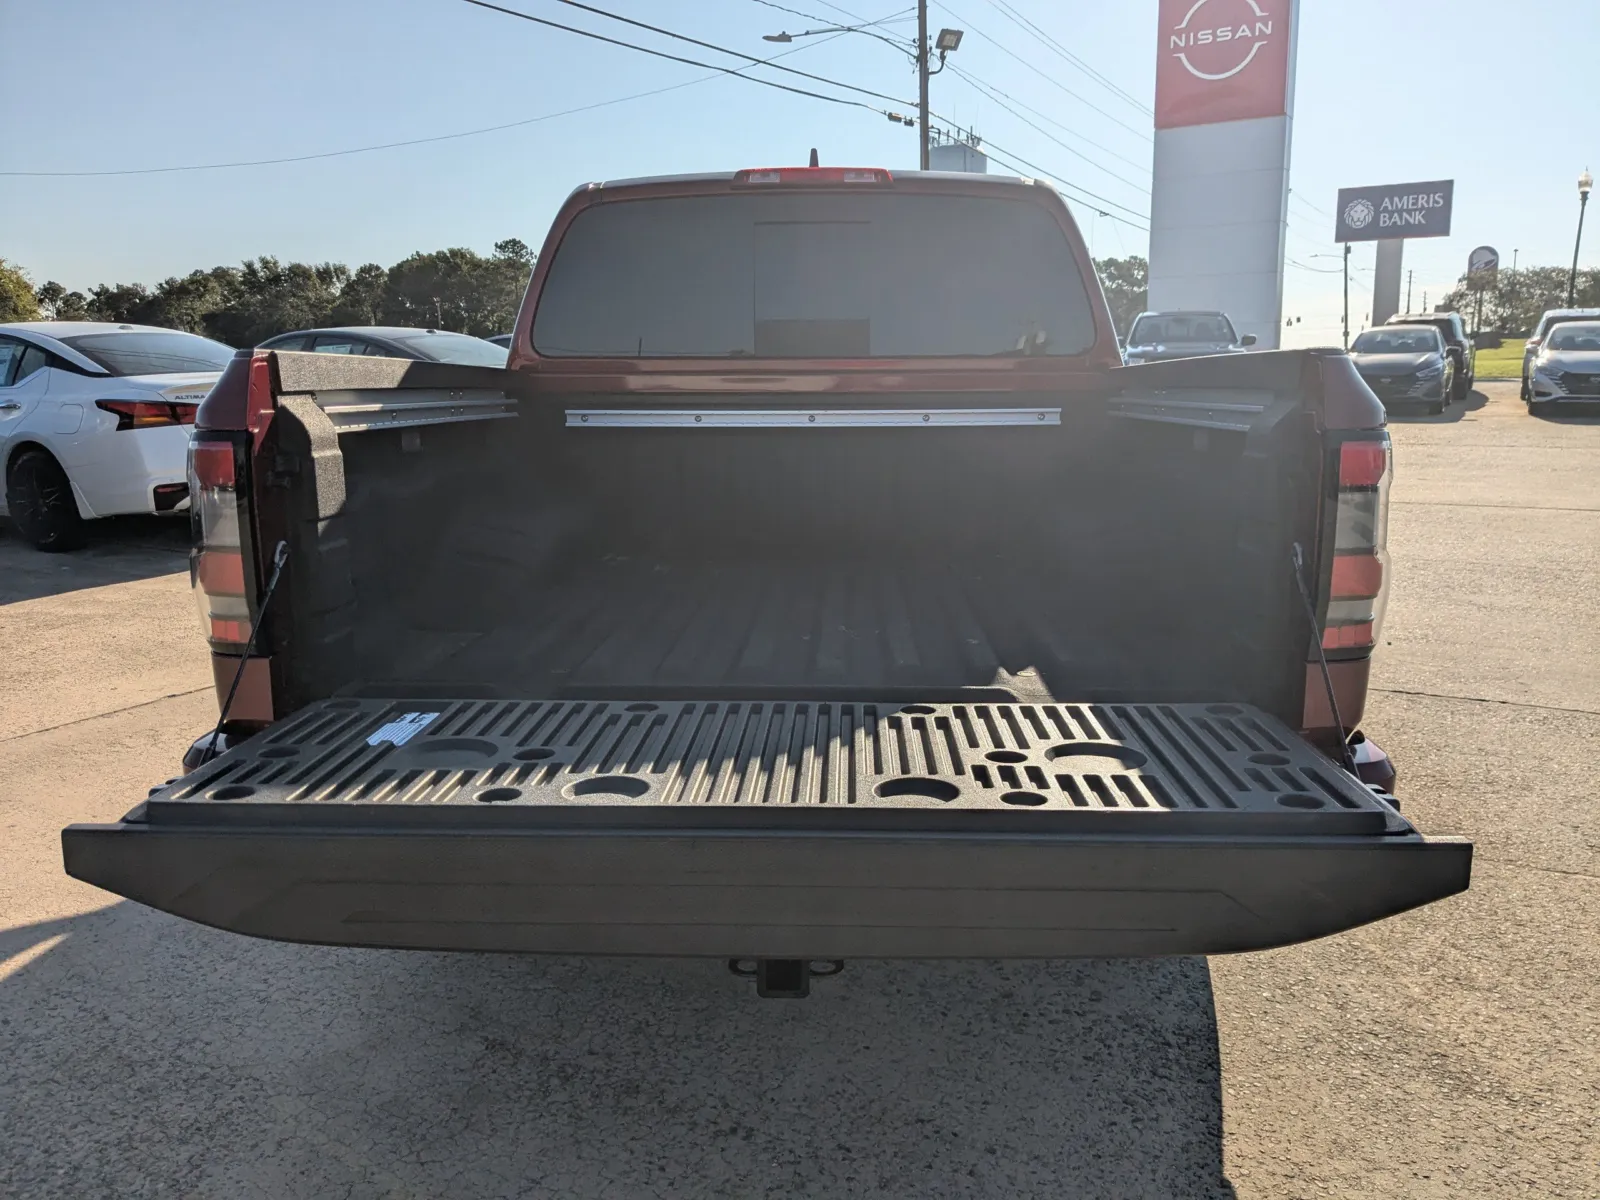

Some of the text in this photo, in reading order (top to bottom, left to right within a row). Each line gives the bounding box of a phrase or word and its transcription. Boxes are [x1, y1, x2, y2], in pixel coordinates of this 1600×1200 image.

[1170, 20, 1272, 49] NISSAN
[1380, 192, 1444, 211] AMERIS
[1380, 210, 1426, 227] BANK
